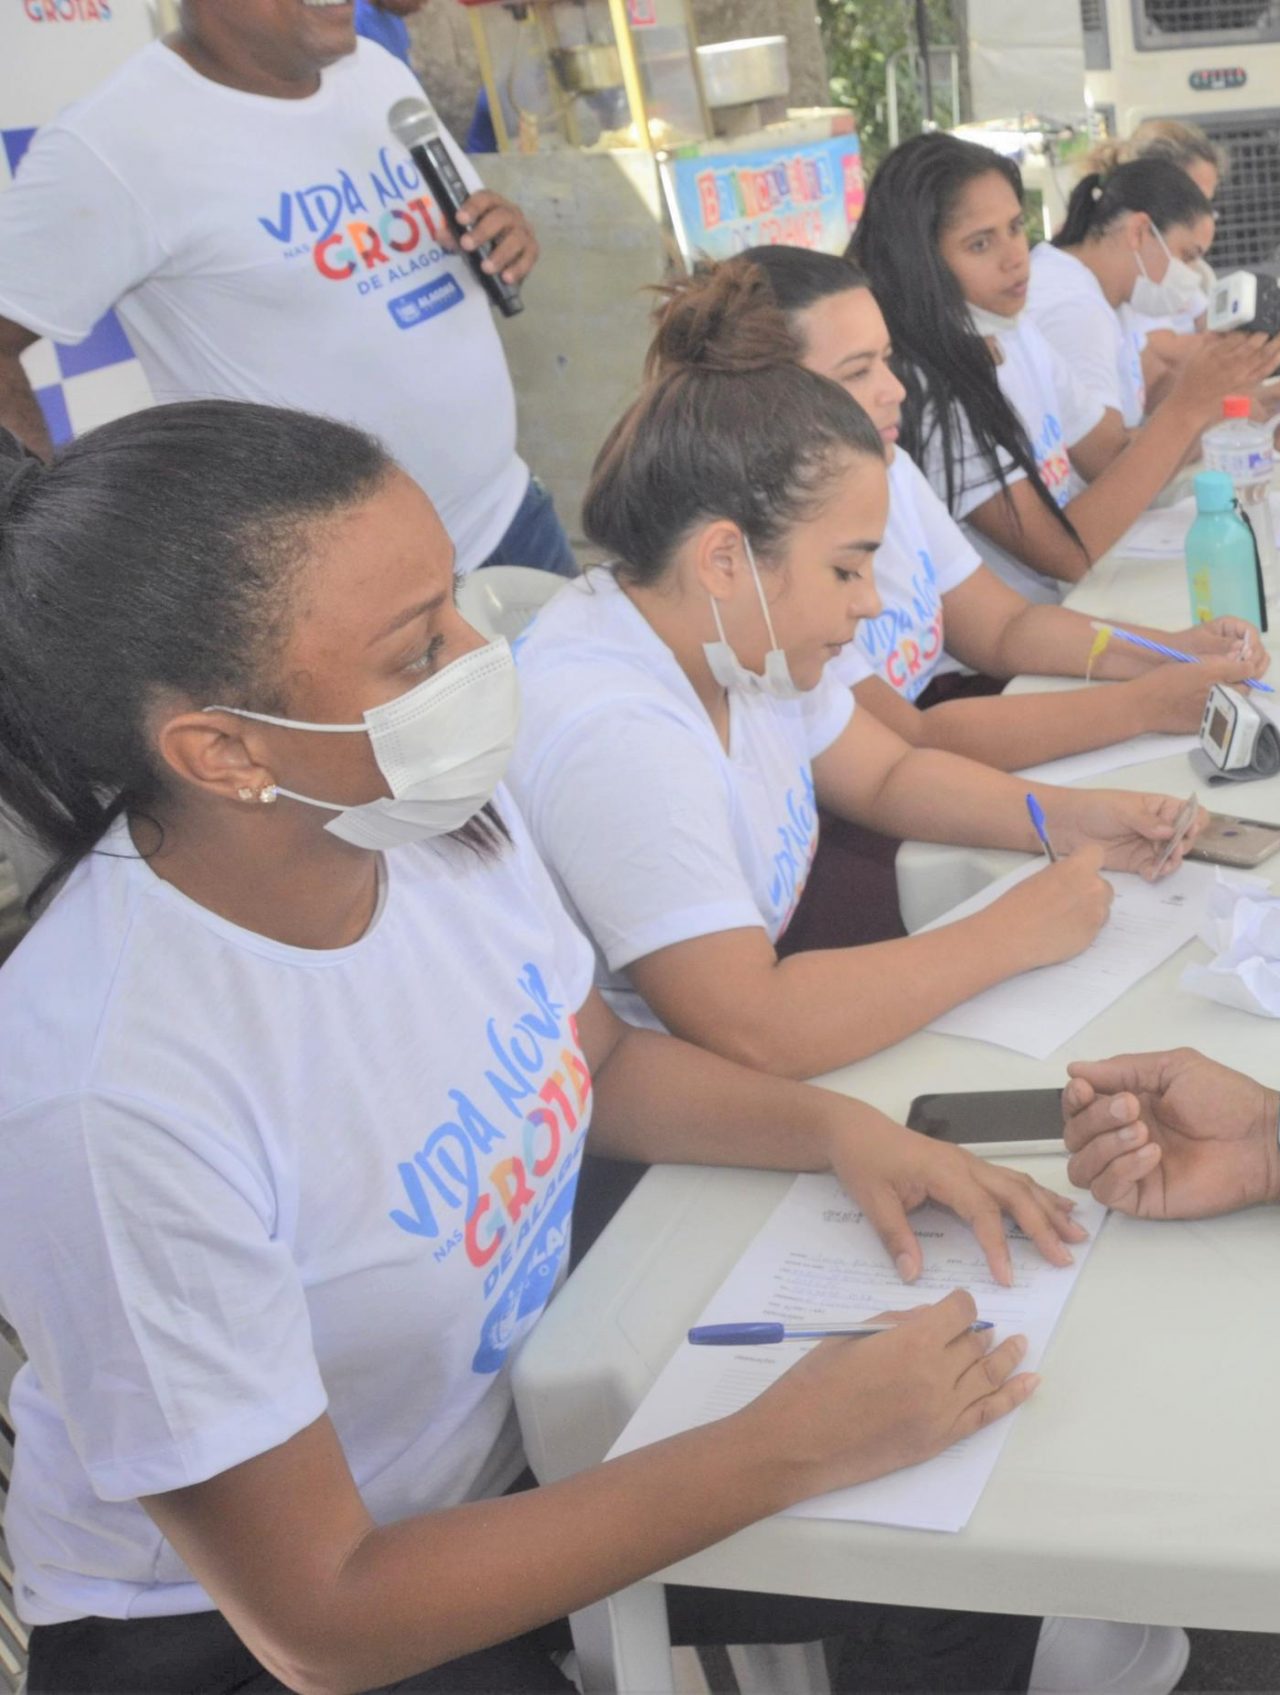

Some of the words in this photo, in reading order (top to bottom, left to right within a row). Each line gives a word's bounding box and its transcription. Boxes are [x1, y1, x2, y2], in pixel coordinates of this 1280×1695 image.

[258, 168, 368, 243] VIDA
[369, 147, 420, 208] NO
[313, 195, 447, 281] GROT
[355, 274, 384, 297] DE
[389, 1088, 506, 1239] VIDA
[484, 962, 565, 1119] NOVA
[464, 1013, 593, 1268] GROTA
[432, 1229, 464, 1264] NAS
